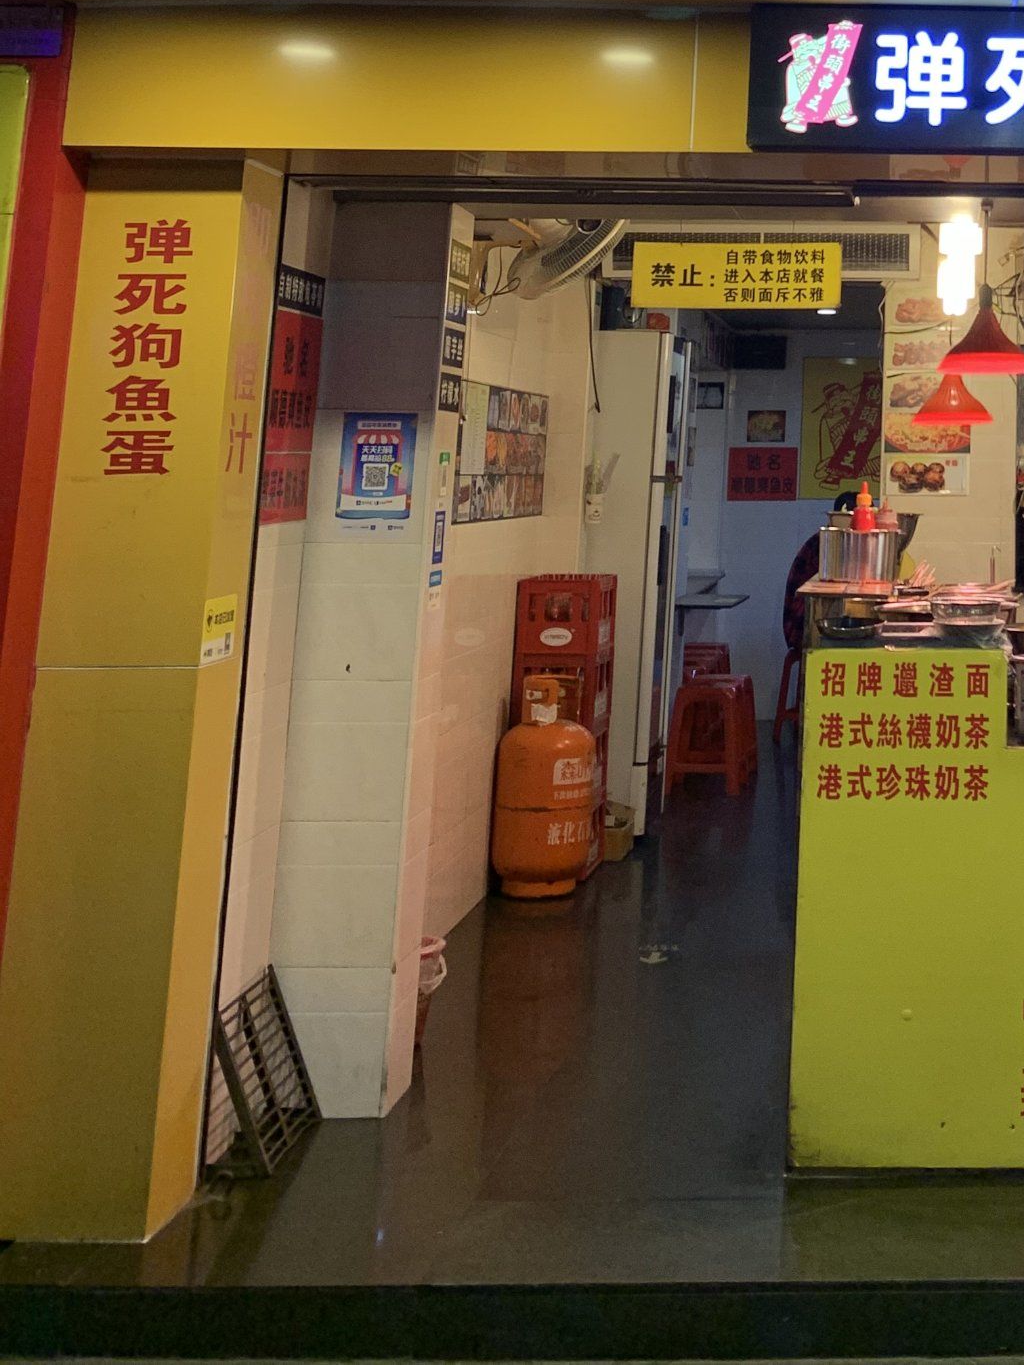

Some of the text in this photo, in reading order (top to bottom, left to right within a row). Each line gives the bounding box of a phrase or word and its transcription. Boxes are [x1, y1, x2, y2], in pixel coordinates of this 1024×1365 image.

[725, 249, 826, 265] 自带食物饮料
[723, 268, 826, 284] 进入本店就餐
[722, 287, 825, 303] 否则面斥不雅
[101, 218, 194, 476] 弹死狗魚蛋
[820, 661, 991, 699] 招牌邋渣面
[818, 712, 990, 749] 港式絲襪奶茶
[816, 763, 989, 802] 港式珍珠奶茶
